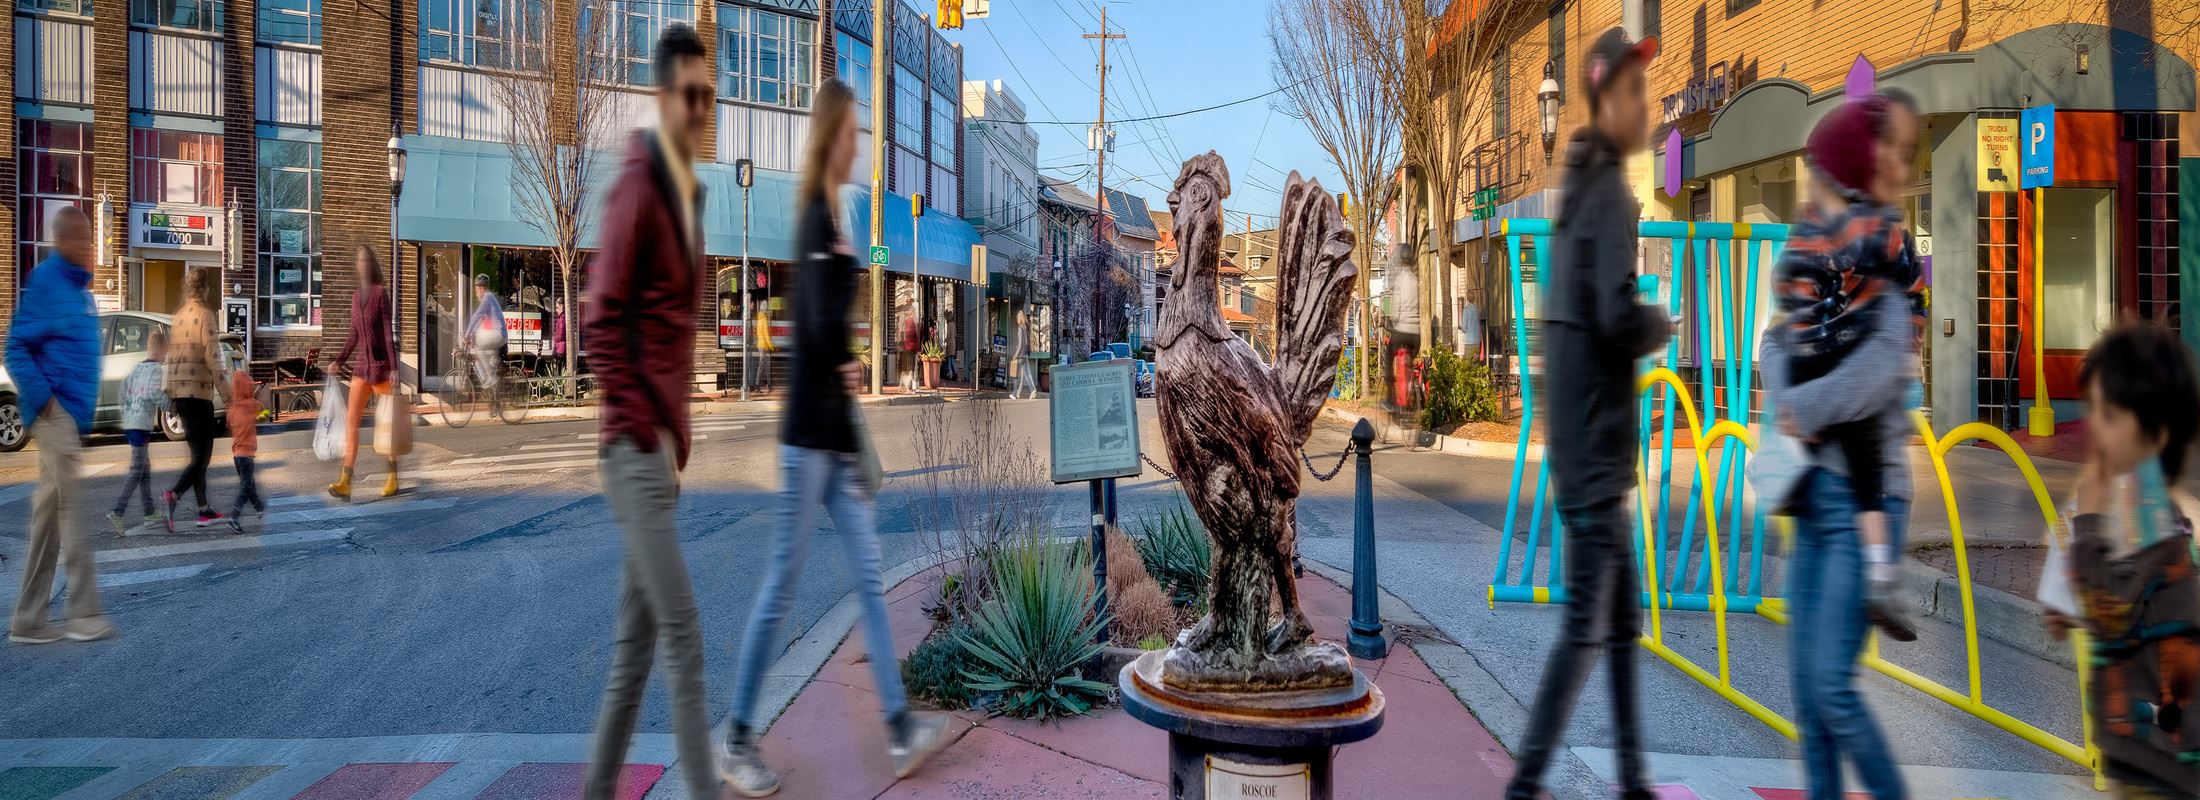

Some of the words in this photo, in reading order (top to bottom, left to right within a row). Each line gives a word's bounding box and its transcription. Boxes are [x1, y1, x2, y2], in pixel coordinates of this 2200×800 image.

[1660, 81, 1706, 123] TRUIST
[1987, 125, 2008, 133] TRUCKS
[1993, 135, 2013, 143] RIGHT
[2031, 122, 2045, 155] P
[2026, 166, 2049, 176] PARKING
[166, 231, 192, 245] 7000
[726, 326, 743, 336] CARP
[1241, 783, 1277, 797] ROSCOE
